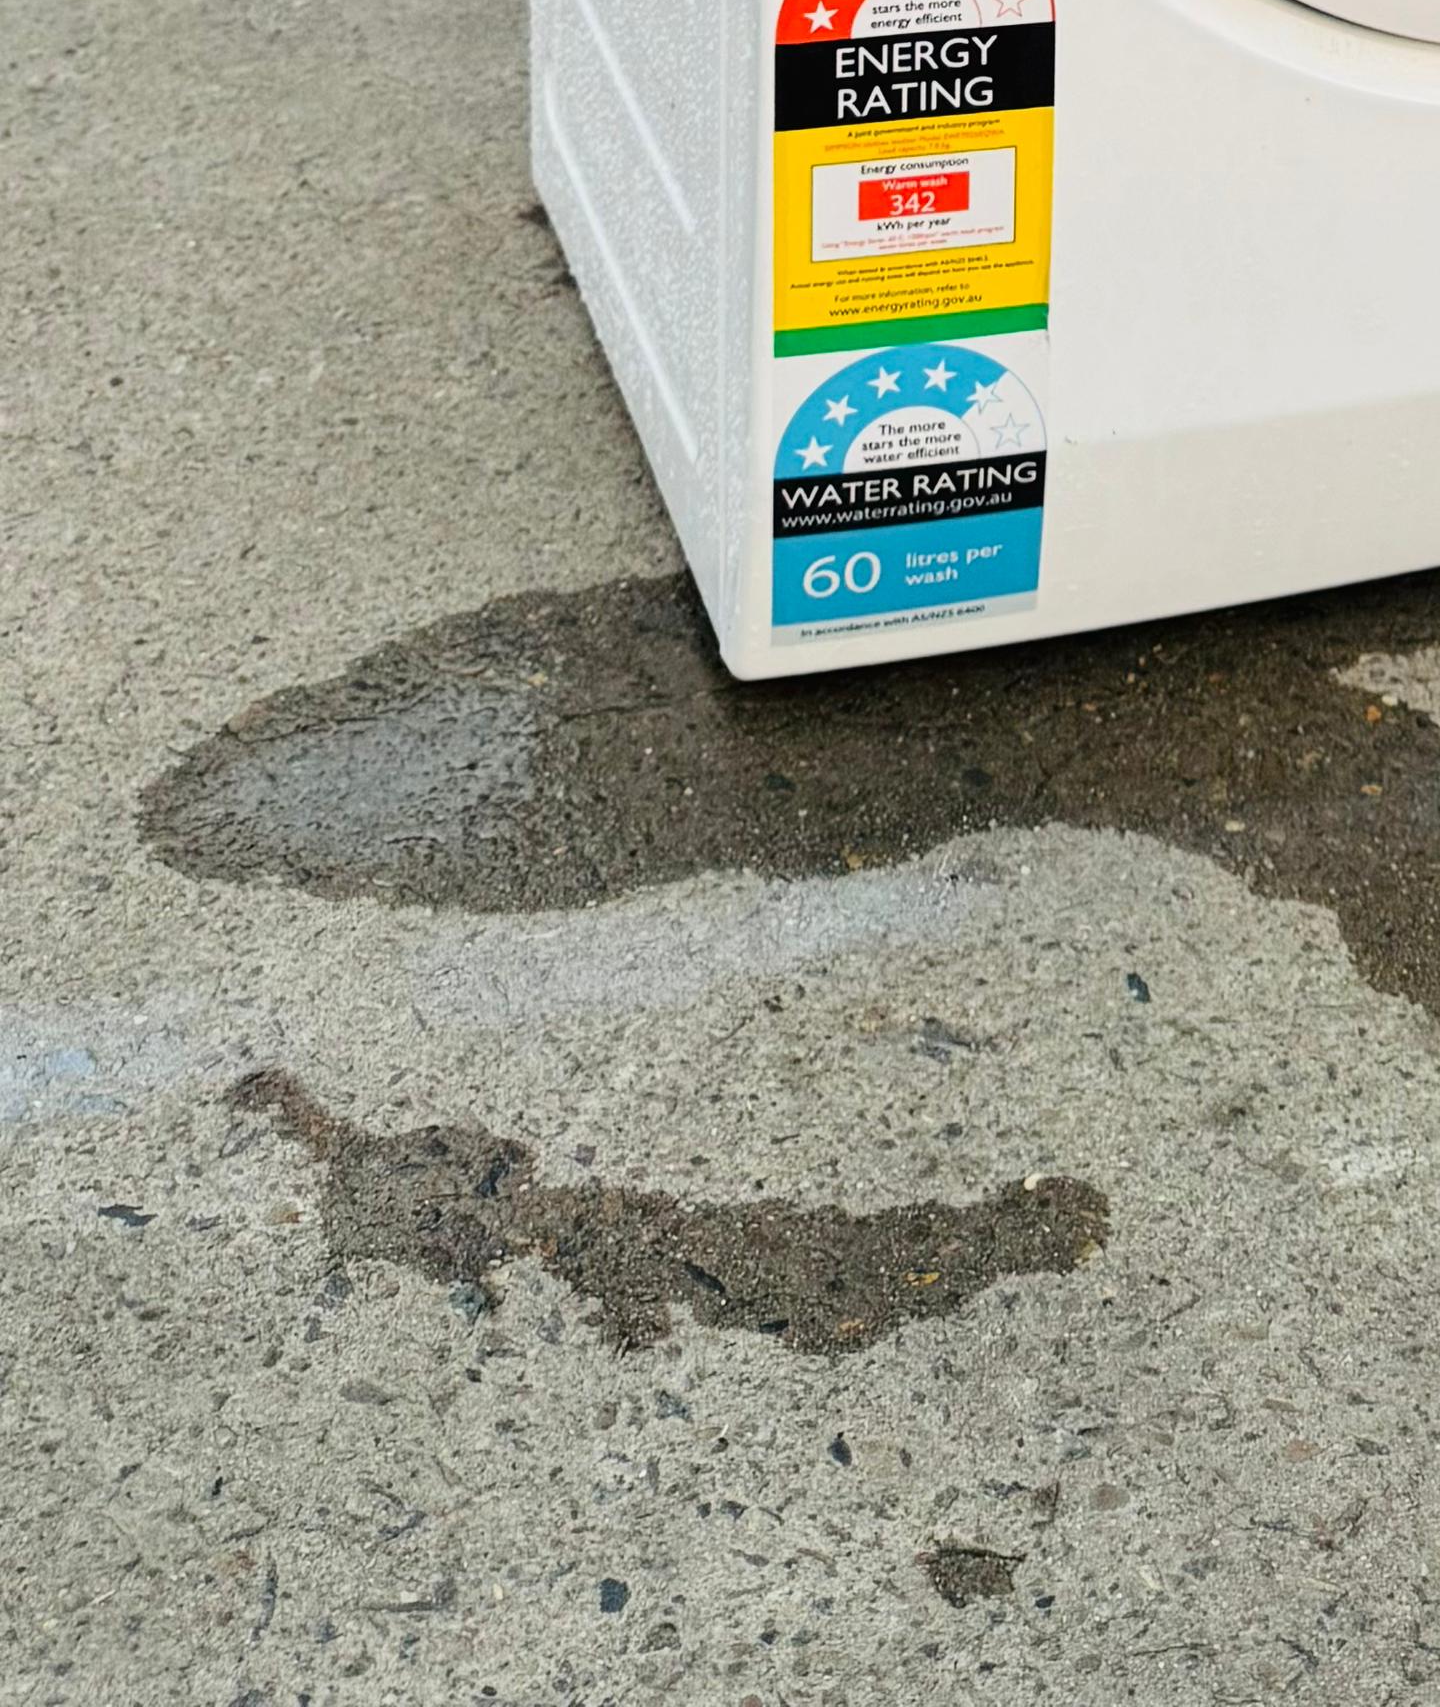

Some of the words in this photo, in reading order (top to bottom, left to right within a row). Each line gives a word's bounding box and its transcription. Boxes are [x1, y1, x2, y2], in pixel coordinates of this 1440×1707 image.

[872, 3, 901, 15] stars
[905, 1, 925, 12] the
[928, 0, 962, 10] more
[870, 18, 911, 29] energy
[915, 13, 963, 25] efficient
[835, 34, 998, 79] ENERGY
[837, 75, 994, 119] RATING
[860, 161, 897, 175] Energy
[900, 156, 969, 172] consumption
[882, 178, 918, 192] Warm
[919, 175, 948, 188] wash
[889, 190, 936, 216] 342
[876, 219, 904, 232] kWh
[907, 219, 925, 231] per
[928, 216, 952, 229] year
[834, 293, 850, 304] For
[852, 292, 876, 302] more
[936, 283, 957, 293] refer
[959, 282, 970, 291] to
[829, 293, 983, 318] www.energyrating.gov.au
[878, 423, 904, 436] The
[908, 420, 946, 433] more
[861, 439, 895, 452] stars
[898, 434, 921, 447] the
[925, 432, 962, 445] more
[863, 451, 904, 464] water
[907, 445, 960, 461] efficient
[781, 477, 902, 510] WATER
[912, 461, 1038, 497] RATING
[781, 490, 1013, 529] www.waterrating.gov.au
[803, 551, 881, 599] 60
[905, 550, 958, 569] litres
[966, 543, 1003, 565] per
[904, 567, 958, 586] wash
[882, 615, 910, 627] with
